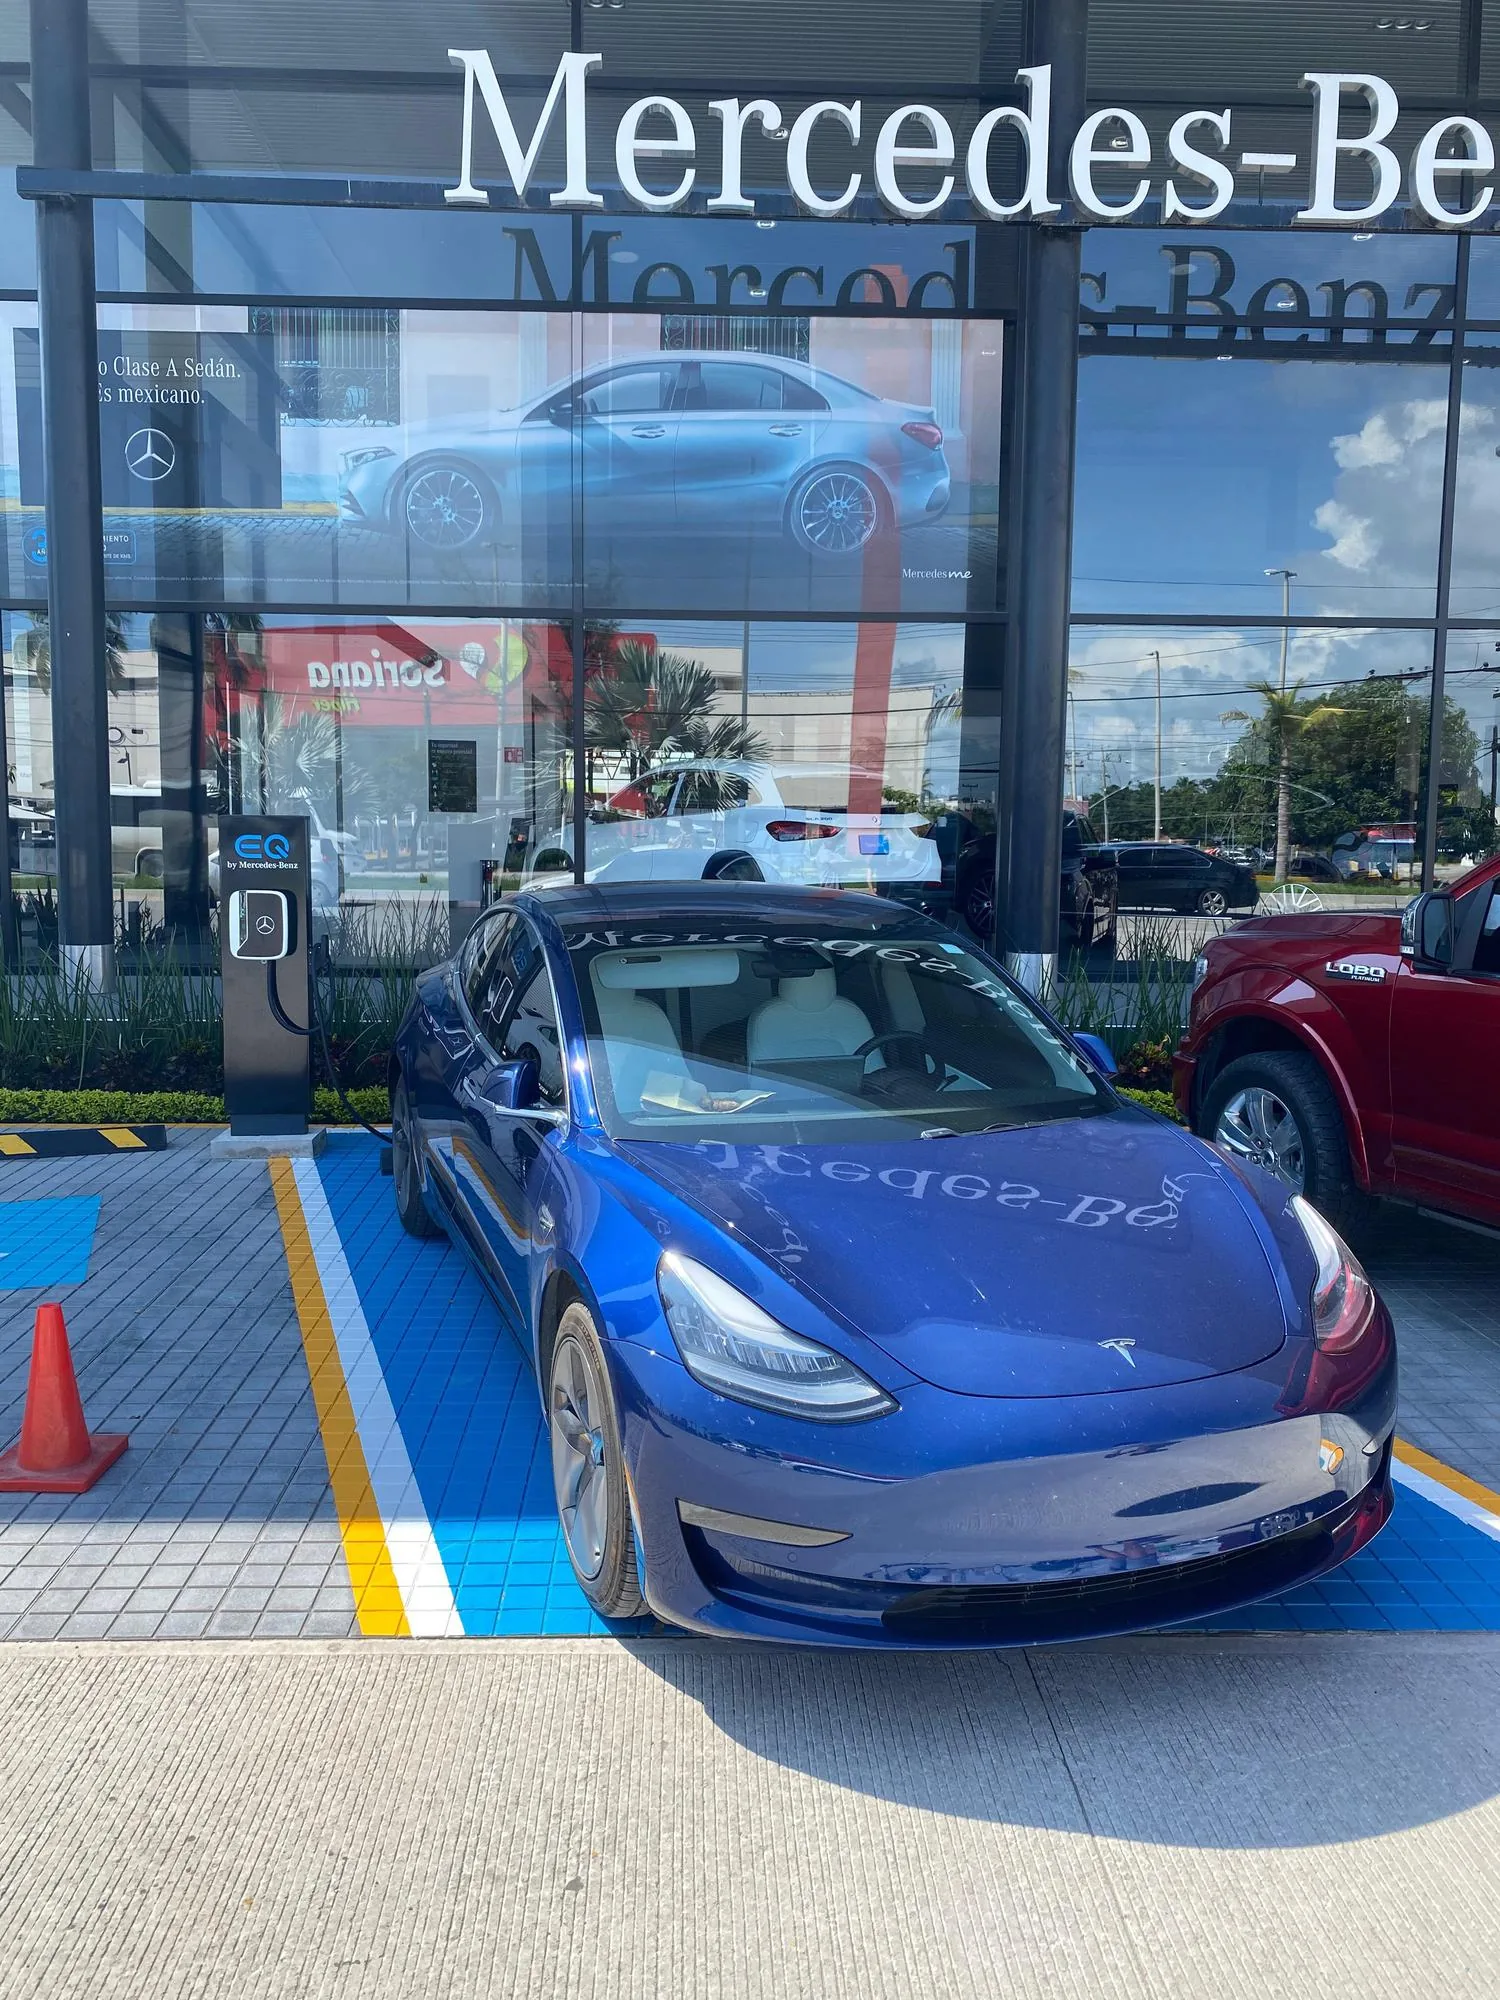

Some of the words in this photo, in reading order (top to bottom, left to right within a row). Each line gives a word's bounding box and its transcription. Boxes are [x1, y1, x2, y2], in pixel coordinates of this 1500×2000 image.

[443, 48, 1498, 229] Mercedes-Be
[113, 356, 160, 377] Clase
[165, 357, 179, 377] A
[184, 357, 241, 378] Sedán.
[118, 384, 205, 404] mexicano.
[234, 833, 290, 859] EQ
[227, 861, 238, 871] by
[239, 860, 299, 870] Mercedes-Benz
[1325, 961, 1386, 979] LOBO
[1351, 974, 1380, 983] PLATINUM
